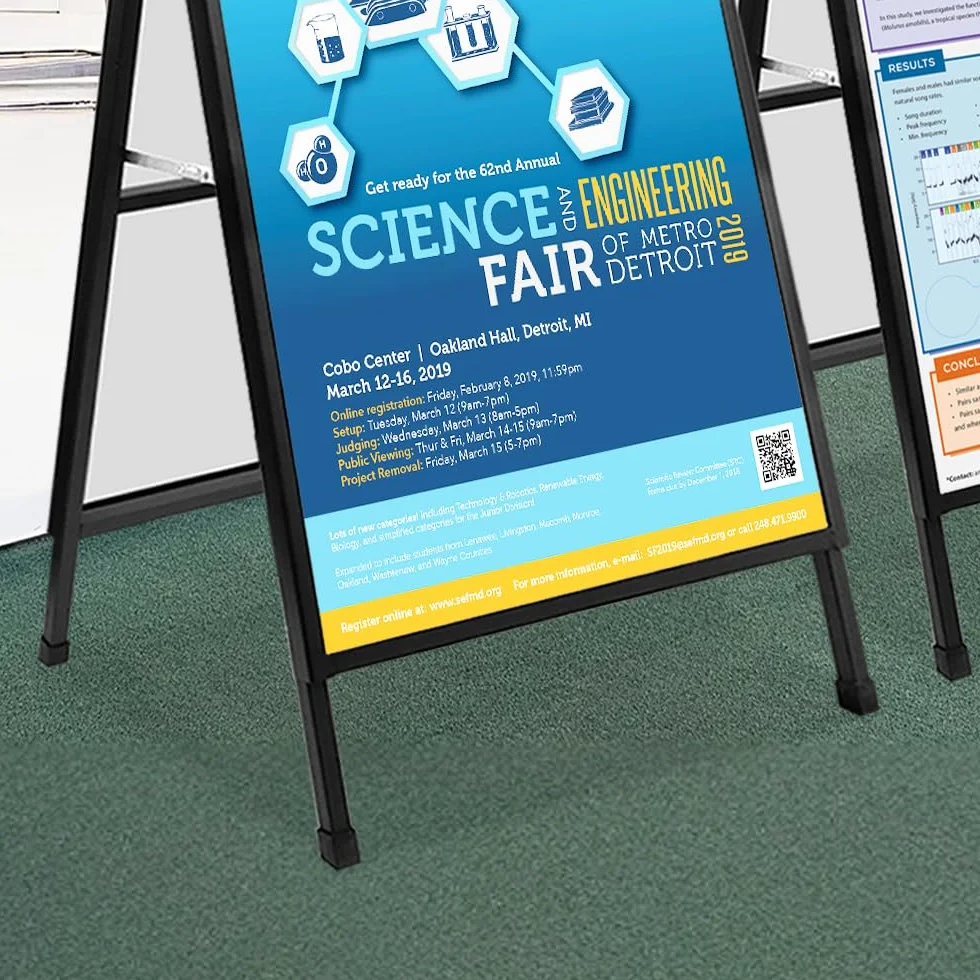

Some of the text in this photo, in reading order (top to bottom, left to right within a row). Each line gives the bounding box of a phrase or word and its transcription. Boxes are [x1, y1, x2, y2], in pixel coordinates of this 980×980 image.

[888, 57, 935, 72] RESULTS
[365, 151, 560, 194] Get ready for the 62nd Annual
[577, 155, 732, 228] ENGINEERING
[307, 185, 557, 276] SCIENCE
[556, 186, 576, 231] AND
[601, 217, 712, 255] OF METRO
[715, 213, 748, 263] 2019
[478, 239, 601, 306] FAIR
[605, 240, 716, 284] DETROIT
[322, 311, 591, 376] Cobo Center Oakland Hall, Detroit, MI
[326, 361, 451, 400] March 12-16, 2019
[330, 364, 582, 422] Online registration: Friday, February 8, 2019, 11:59pm
[332, 392, 509, 438] Setup: Tuesday, March 12 (9am-7pm)
[336, 401, 539, 454] Judging: Wednesday, March 13 (8am-5pm)
[337, 410, 576, 470] Public Viewing: Thur Fri, March 14-15 (9am-7pm)
[340, 433, 541, 486] Project Removal: Friday, March 15 (5-7pm)
